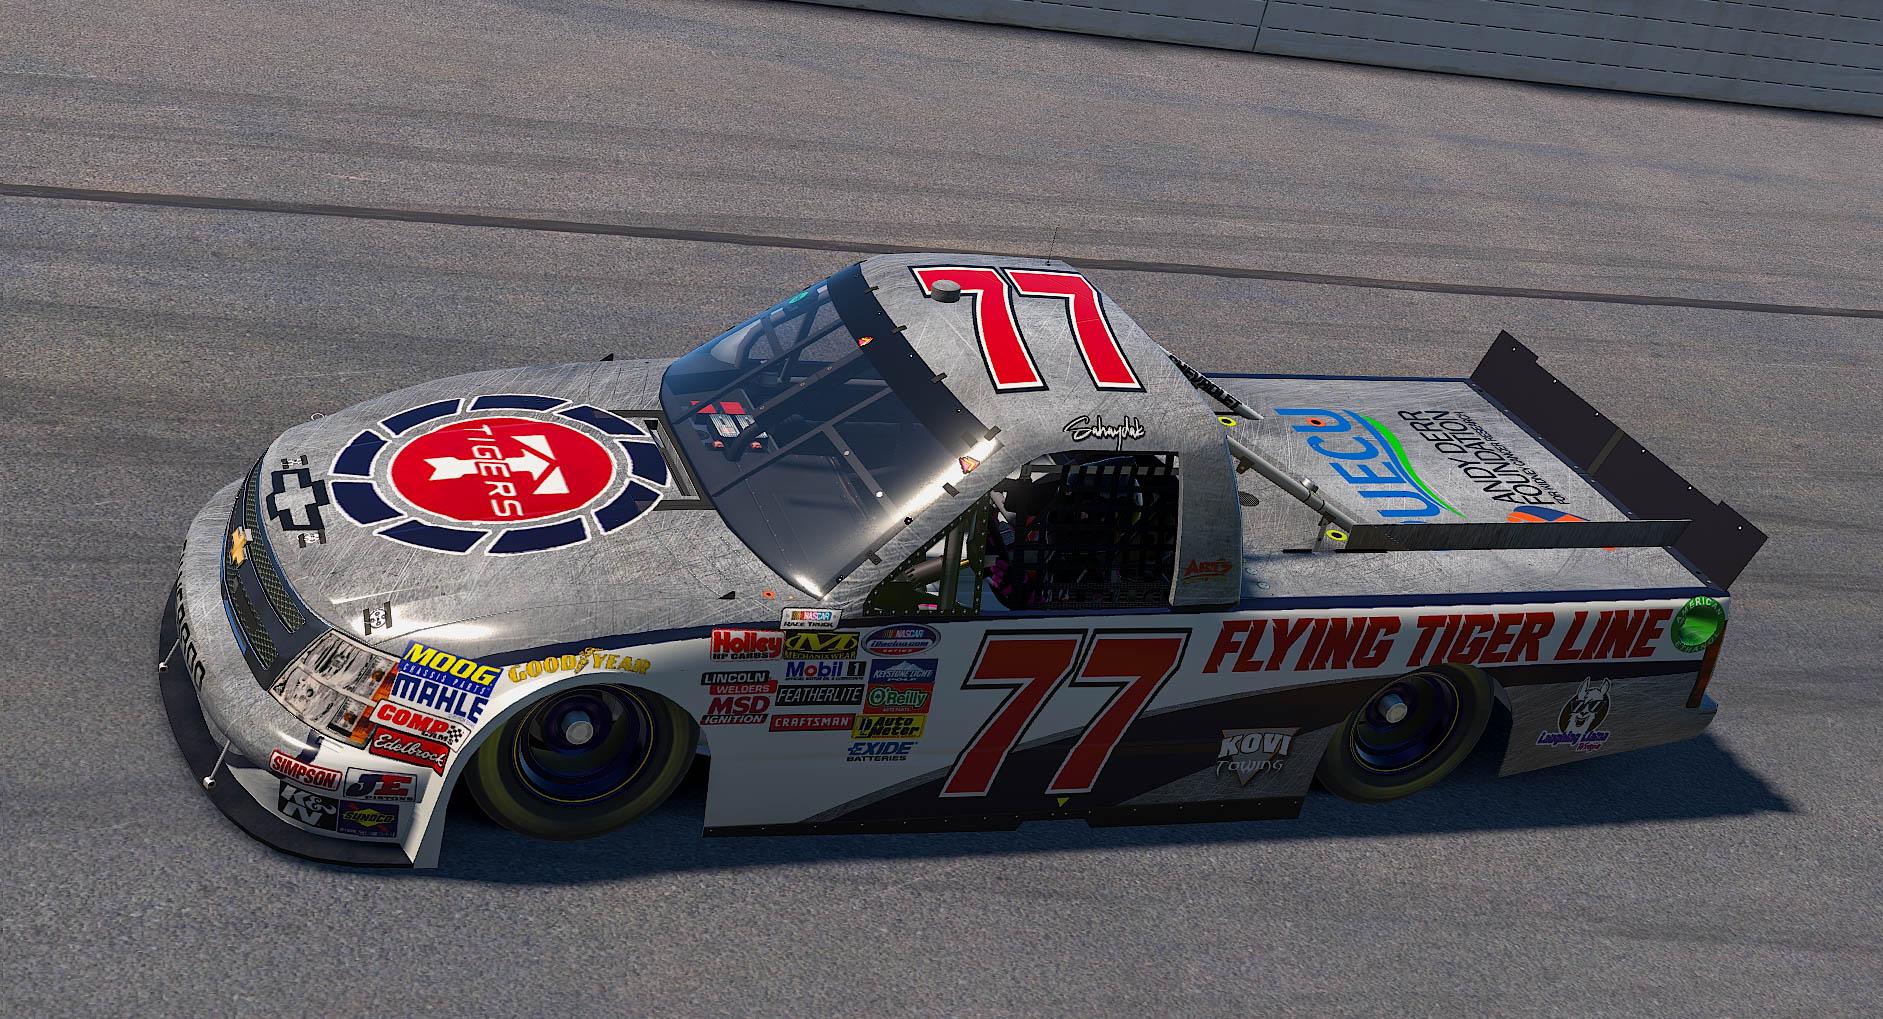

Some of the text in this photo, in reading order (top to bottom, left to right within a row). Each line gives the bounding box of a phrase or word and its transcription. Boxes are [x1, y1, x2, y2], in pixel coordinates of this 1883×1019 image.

[908, 265, 1147, 393] 77
[1397, 410, 1524, 504] ANDY DERR
[1424, 410, 1555, 505] FOUNDATION
[470, 424, 524, 518] TIGERS
[803, 611, 832, 621] NASCAR
[713, 632, 782, 658] Holley
[896, 629, 924, 638] NASCAR
[1202, 608, 1674, 674] FLYING TIGER LINE
[403, 643, 501, 686] MOOG
[786, 661, 843, 676] Mobil
[403, 663, 488, 695] CHASSIS PARTS
[705, 672, 766, 684] LINCOLN
[716, 684, 770, 694] WELDERS
[392, 672, 490, 723] MAHLE
[707, 696, 771, 715] MSD
[778, 687, 861, 704] FEATHERLITE
[869, 687, 928, 707] O'Reilly
[377, 703, 449, 733] COMP
[704, 714, 763, 725] IGNITION
[775, 716, 849, 728] CRAFTSMAN
[874, 716, 913, 726] Auto
[939, 628, 1192, 798] 77
[374, 733, 448, 767] Edelbrock
[421, 730, 454, 746] CAMS
[848, 741, 914, 756] EXIDE
[1218, 733, 1292, 758] KOVI
[272, 755, 337, 789] SIMPSON
[347, 773, 413, 797] JE
[280, 785, 337, 826] K&N
[344, 810, 396, 823] SUNOCO
